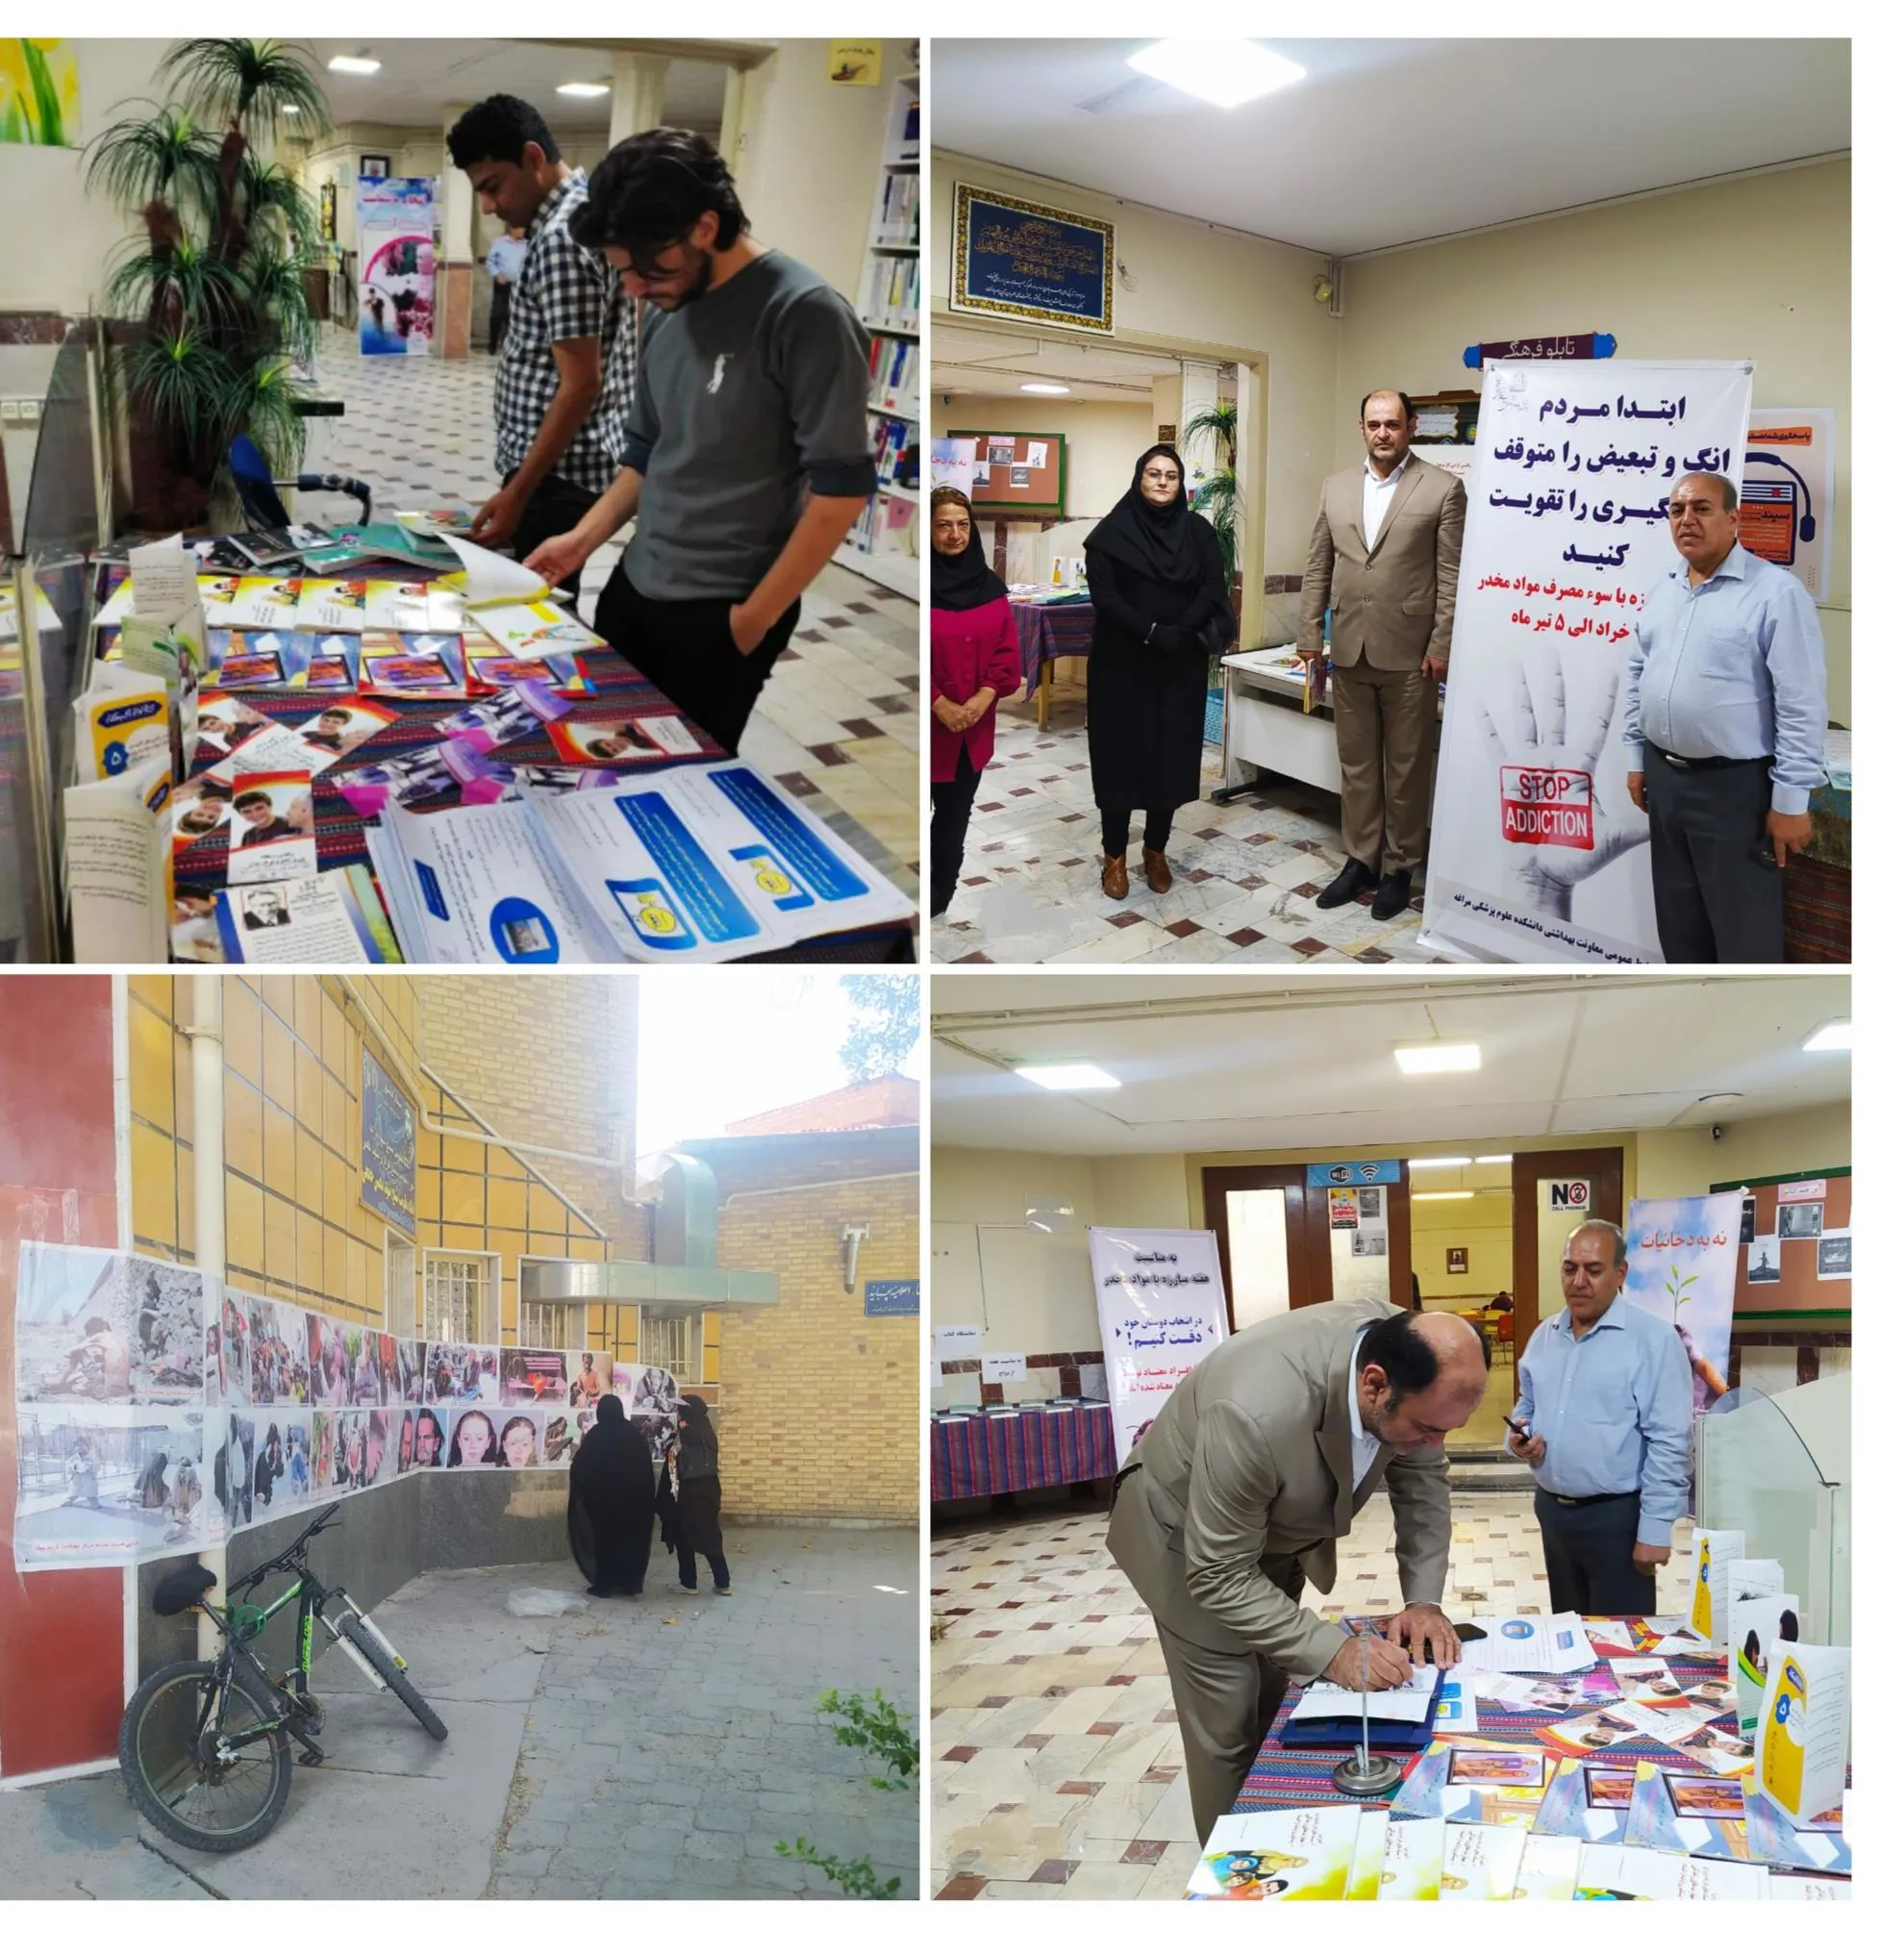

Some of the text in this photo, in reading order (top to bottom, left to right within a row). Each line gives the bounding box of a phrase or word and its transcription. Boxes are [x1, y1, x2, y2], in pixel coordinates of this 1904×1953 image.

[1539, 394, 1686, 426] ابتدا مردم
[1493, 437, 1555, 468] متوقف
[1563, 440, 1580, 471] را
[1586, 443, 1658, 474] تبعیض
[1683, 446, 1731, 473] انگ
[1661, 455, 1675, 477] و
[1489, 488, 1565, 517] تقویت
[1569, 488, 1588, 521] را
[1563, 543, 1630, 571] کنید
[1477, 572, 1510, 590] مخدر
[1513, 576, 1541, 596] مواد
[1543, 579, 1584, 601] مصرف
[1587, 589, 1612, 606] سوء
[1616, 588, 1626, 608] با
[1511, 609, 1531, 625] ماه
[1533, 613, 1553, 632] تیر
[1554, 613, 1566, 632] ۵
[1567, 617, 1592, 638] الی
[1518, 772, 1570, 802] STOP
[1505, 806, 1588, 837] ADDICTION
[1454, 893, 1471, 907] مراغه
[1471, 902, 1495, 917] پزشکی
[1496, 910, 1513, 921] علوم
[1514, 916, 1543, 932] دانشکده
[1543, 929, 1575, 946] بهداشتی
[1576, 939, 1604, 955] معاونت
[1641, 1229, 1728, 1252] نه به دخانیات
[1168, 1315, 1192, 1326] انتخاب
[1193, 1317, 1203, 1327] در
[1168, 1329, 1202, 1345] دقت
